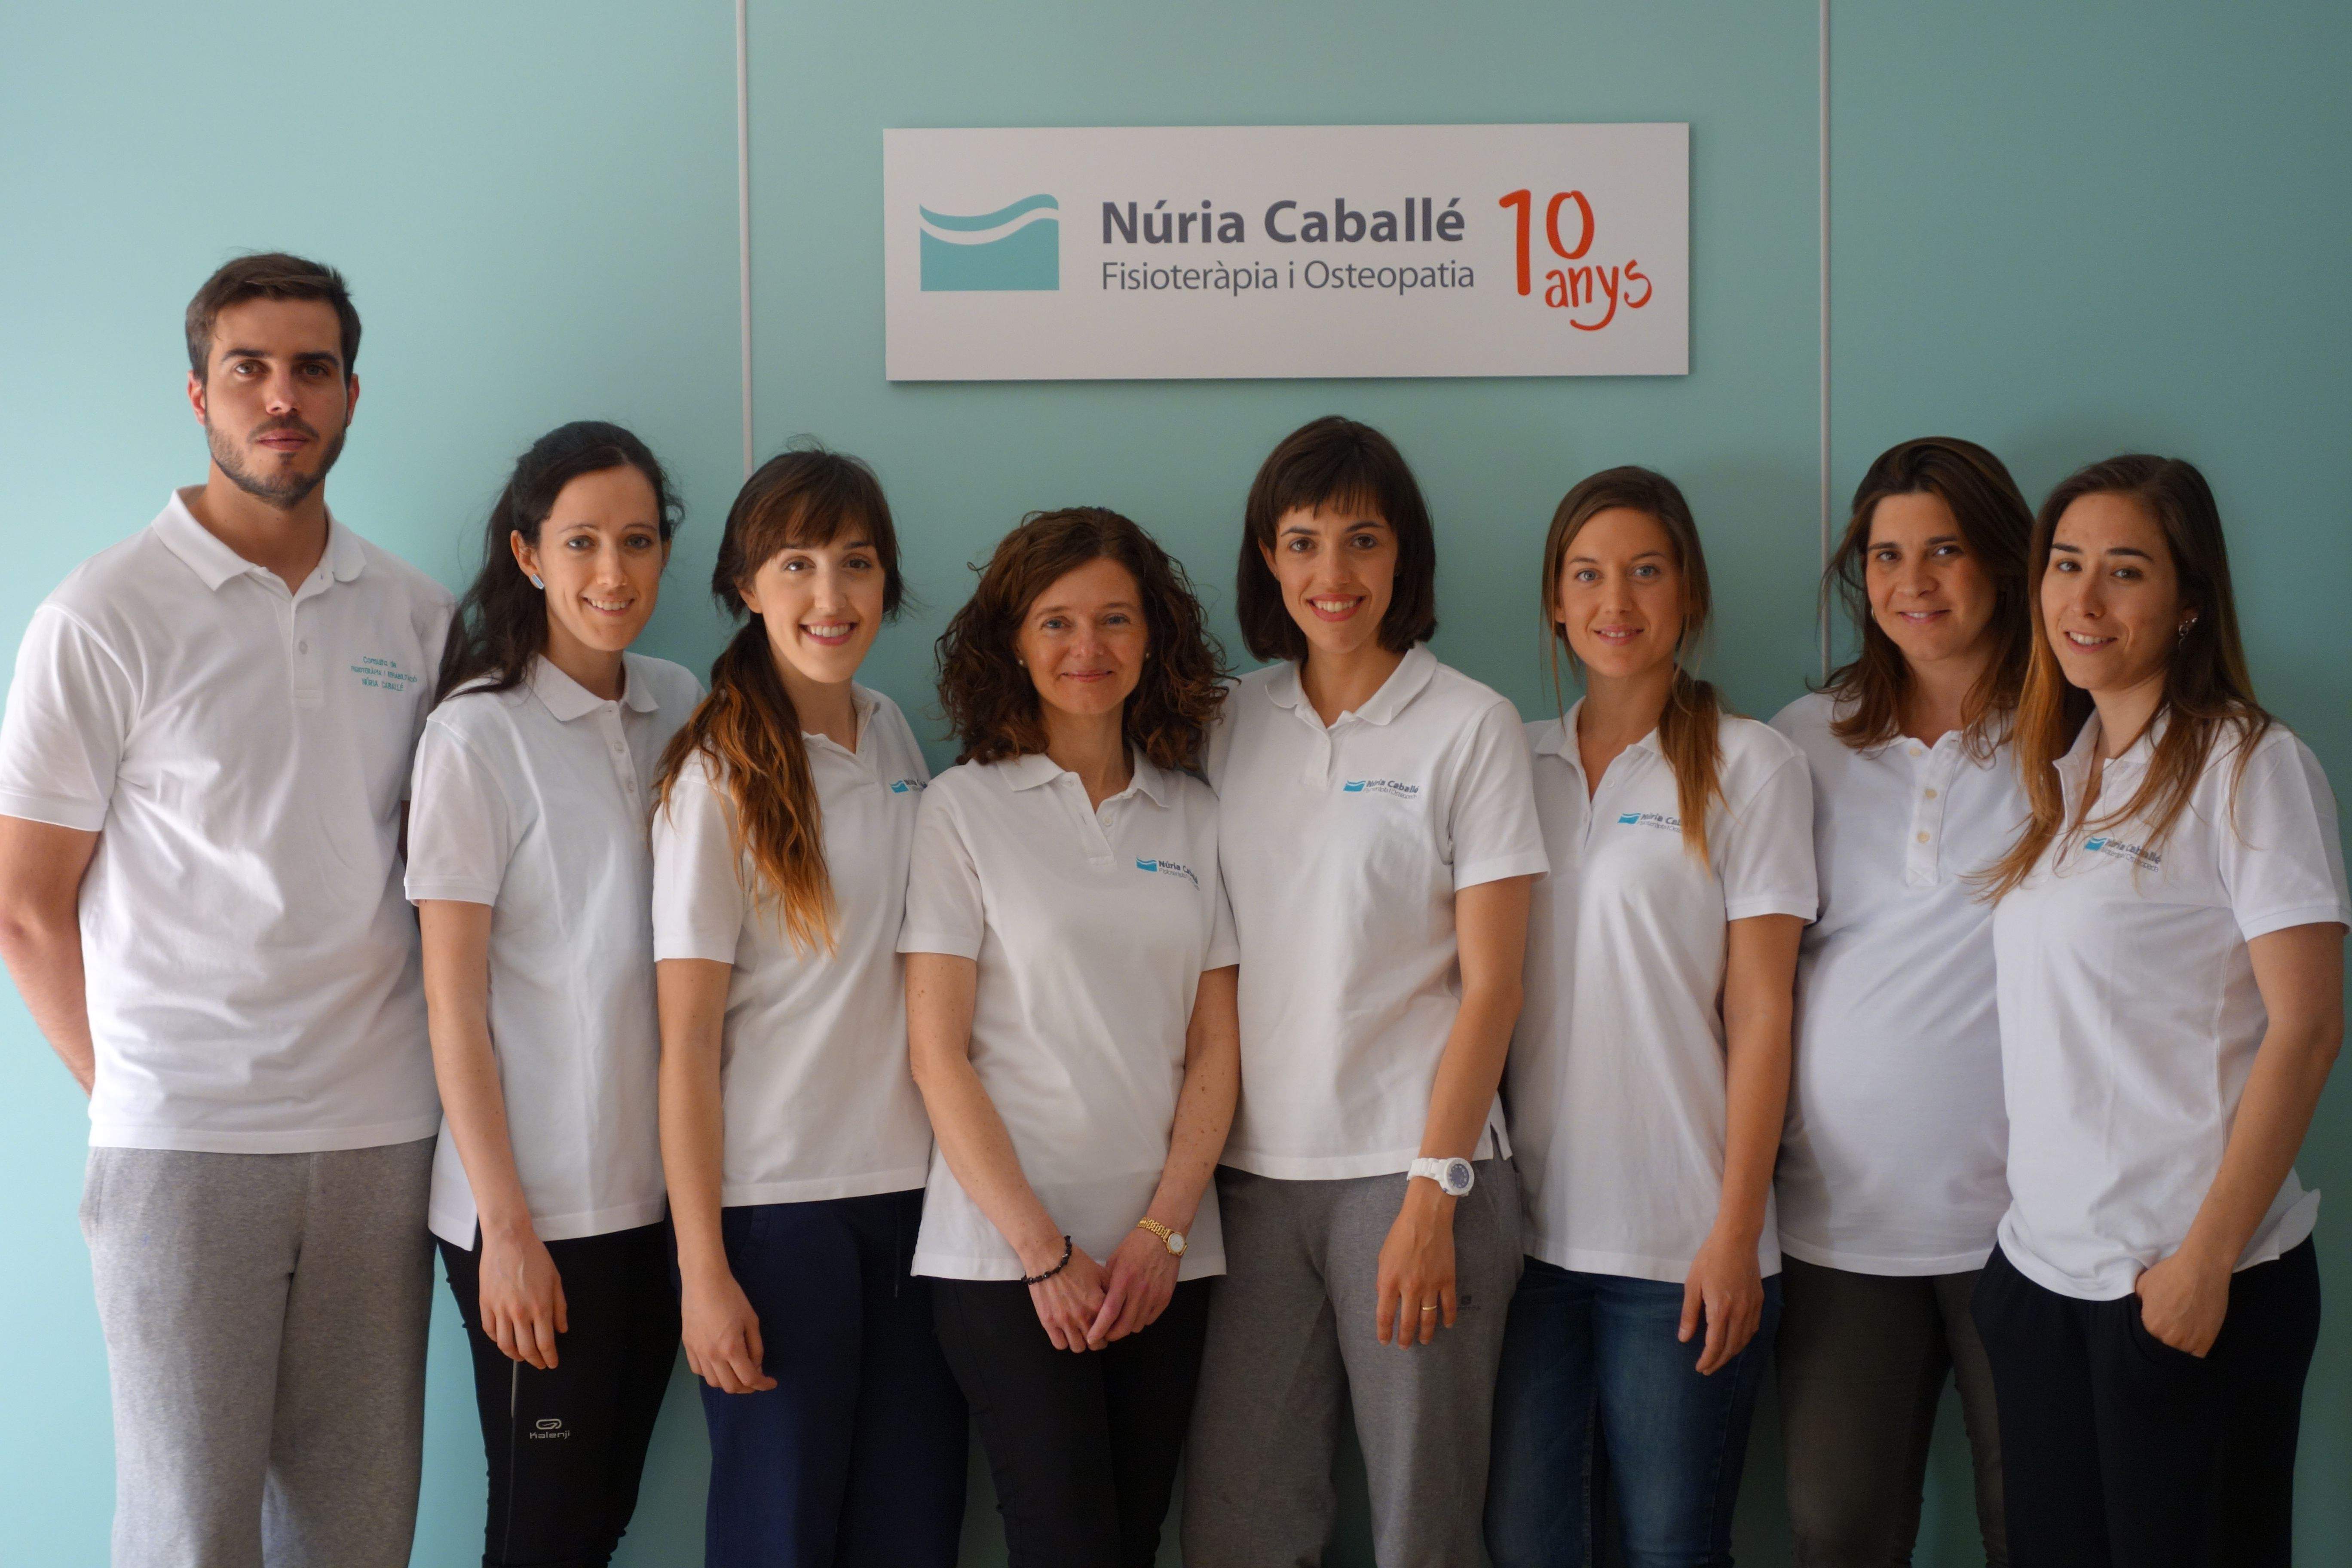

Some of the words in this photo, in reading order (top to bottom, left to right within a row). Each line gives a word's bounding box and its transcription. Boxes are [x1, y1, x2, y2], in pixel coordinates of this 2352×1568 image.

[1102, 199, 1244, 244] Núria
[1265, 197, 1465, 243] Caballé
[1499, 189, 1595, 296] 10
[1103, 260, 1278, 297] Fisioteràpia
[1289, 260, 1293, 288] i
[1304, 260, 1474, 295] Osteopatia
[1545, 259, 1652, 331] anys
[1387, 780, 1420, 793] Caballé
[1158, 860, 1181, 870] Núria
[529, 1430, 570, 1440] Kalenji
